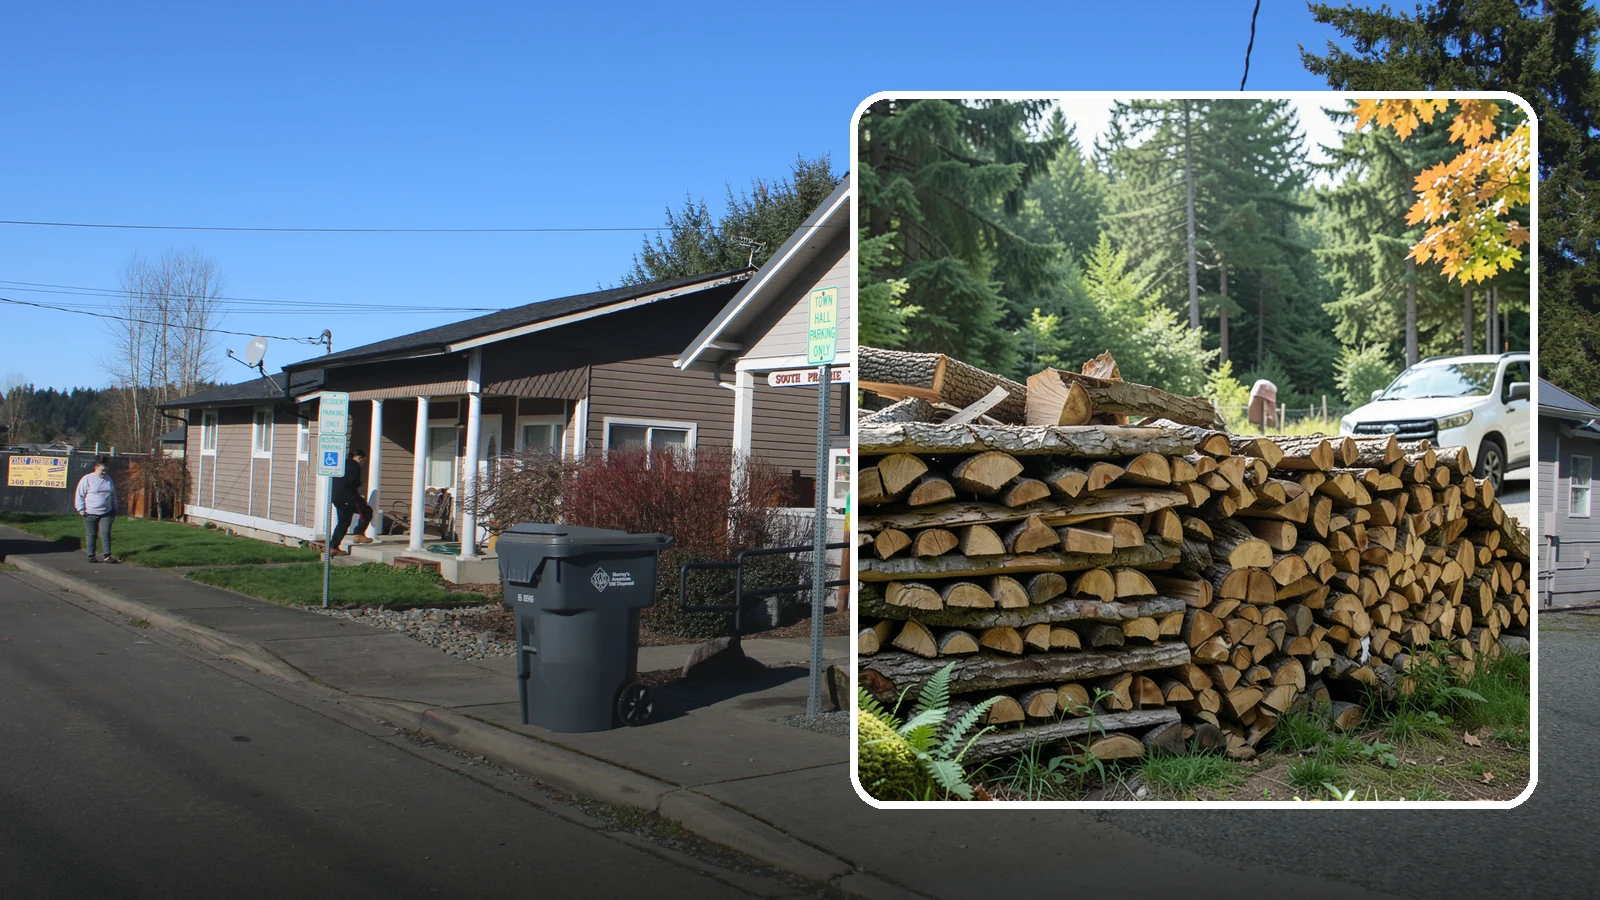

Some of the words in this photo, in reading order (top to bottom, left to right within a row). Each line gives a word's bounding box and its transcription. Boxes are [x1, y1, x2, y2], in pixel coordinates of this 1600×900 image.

[815, 295, 832, 308] TOWN
[814, 311, 831, 324] HALL
[810, 327, 835, 340] PARKING
[813, 344, 830, 357] ONLY
[775, 373, 801, 384] SOUTH
[807, 370, 842, 382] PRIE
